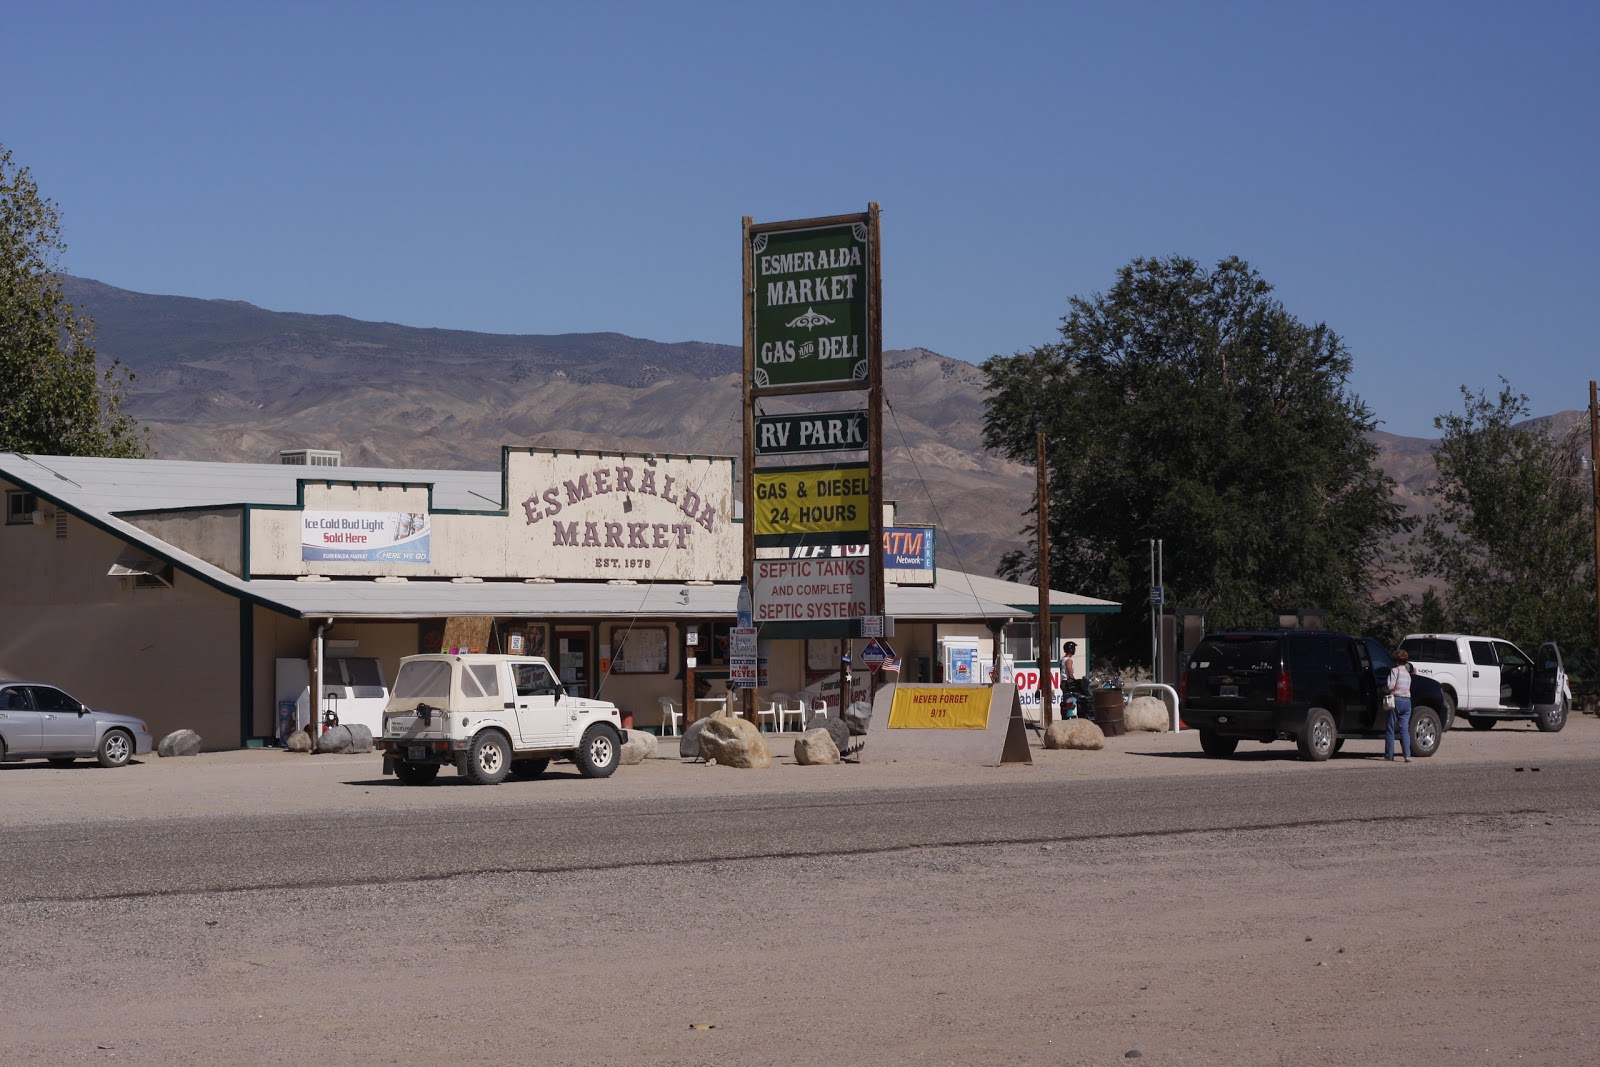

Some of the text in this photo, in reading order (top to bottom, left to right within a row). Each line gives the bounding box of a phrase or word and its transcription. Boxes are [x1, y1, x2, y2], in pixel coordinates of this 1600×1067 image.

[761, 246, 862, 276] ESMERALDA
[767, 274, 858, 306] MARKET
[761, 335, 859, 364] GAS AND DELI
[761, 418, 863, 447] RV PARK
[757, 478, 869, 500] GAS & DIESEL
[521, 466, 717, 534] ESMERALDA
[770, 504, 857, 524] 24 HOURS
[305, 518, 384, 532] Ice Cold Bud Light
[552, 520, 692, 549] MARKET
[323, 532, 367, 543] Sold Here
[883, 532, 924, 555] ATM
[759, 559, 865, 579] SEPTIC TANKS
[896, 555, 921, 565] Network
[771, 583, 853, 596] AND COMPLETE
[759, 601, 866, 619] SEPTIC SYSTEMS
[731, 670, 756, 678] KEYES
[913, 694, 968, 704] NEVER FORGET
[930, 709, 946, 718] 9/11
